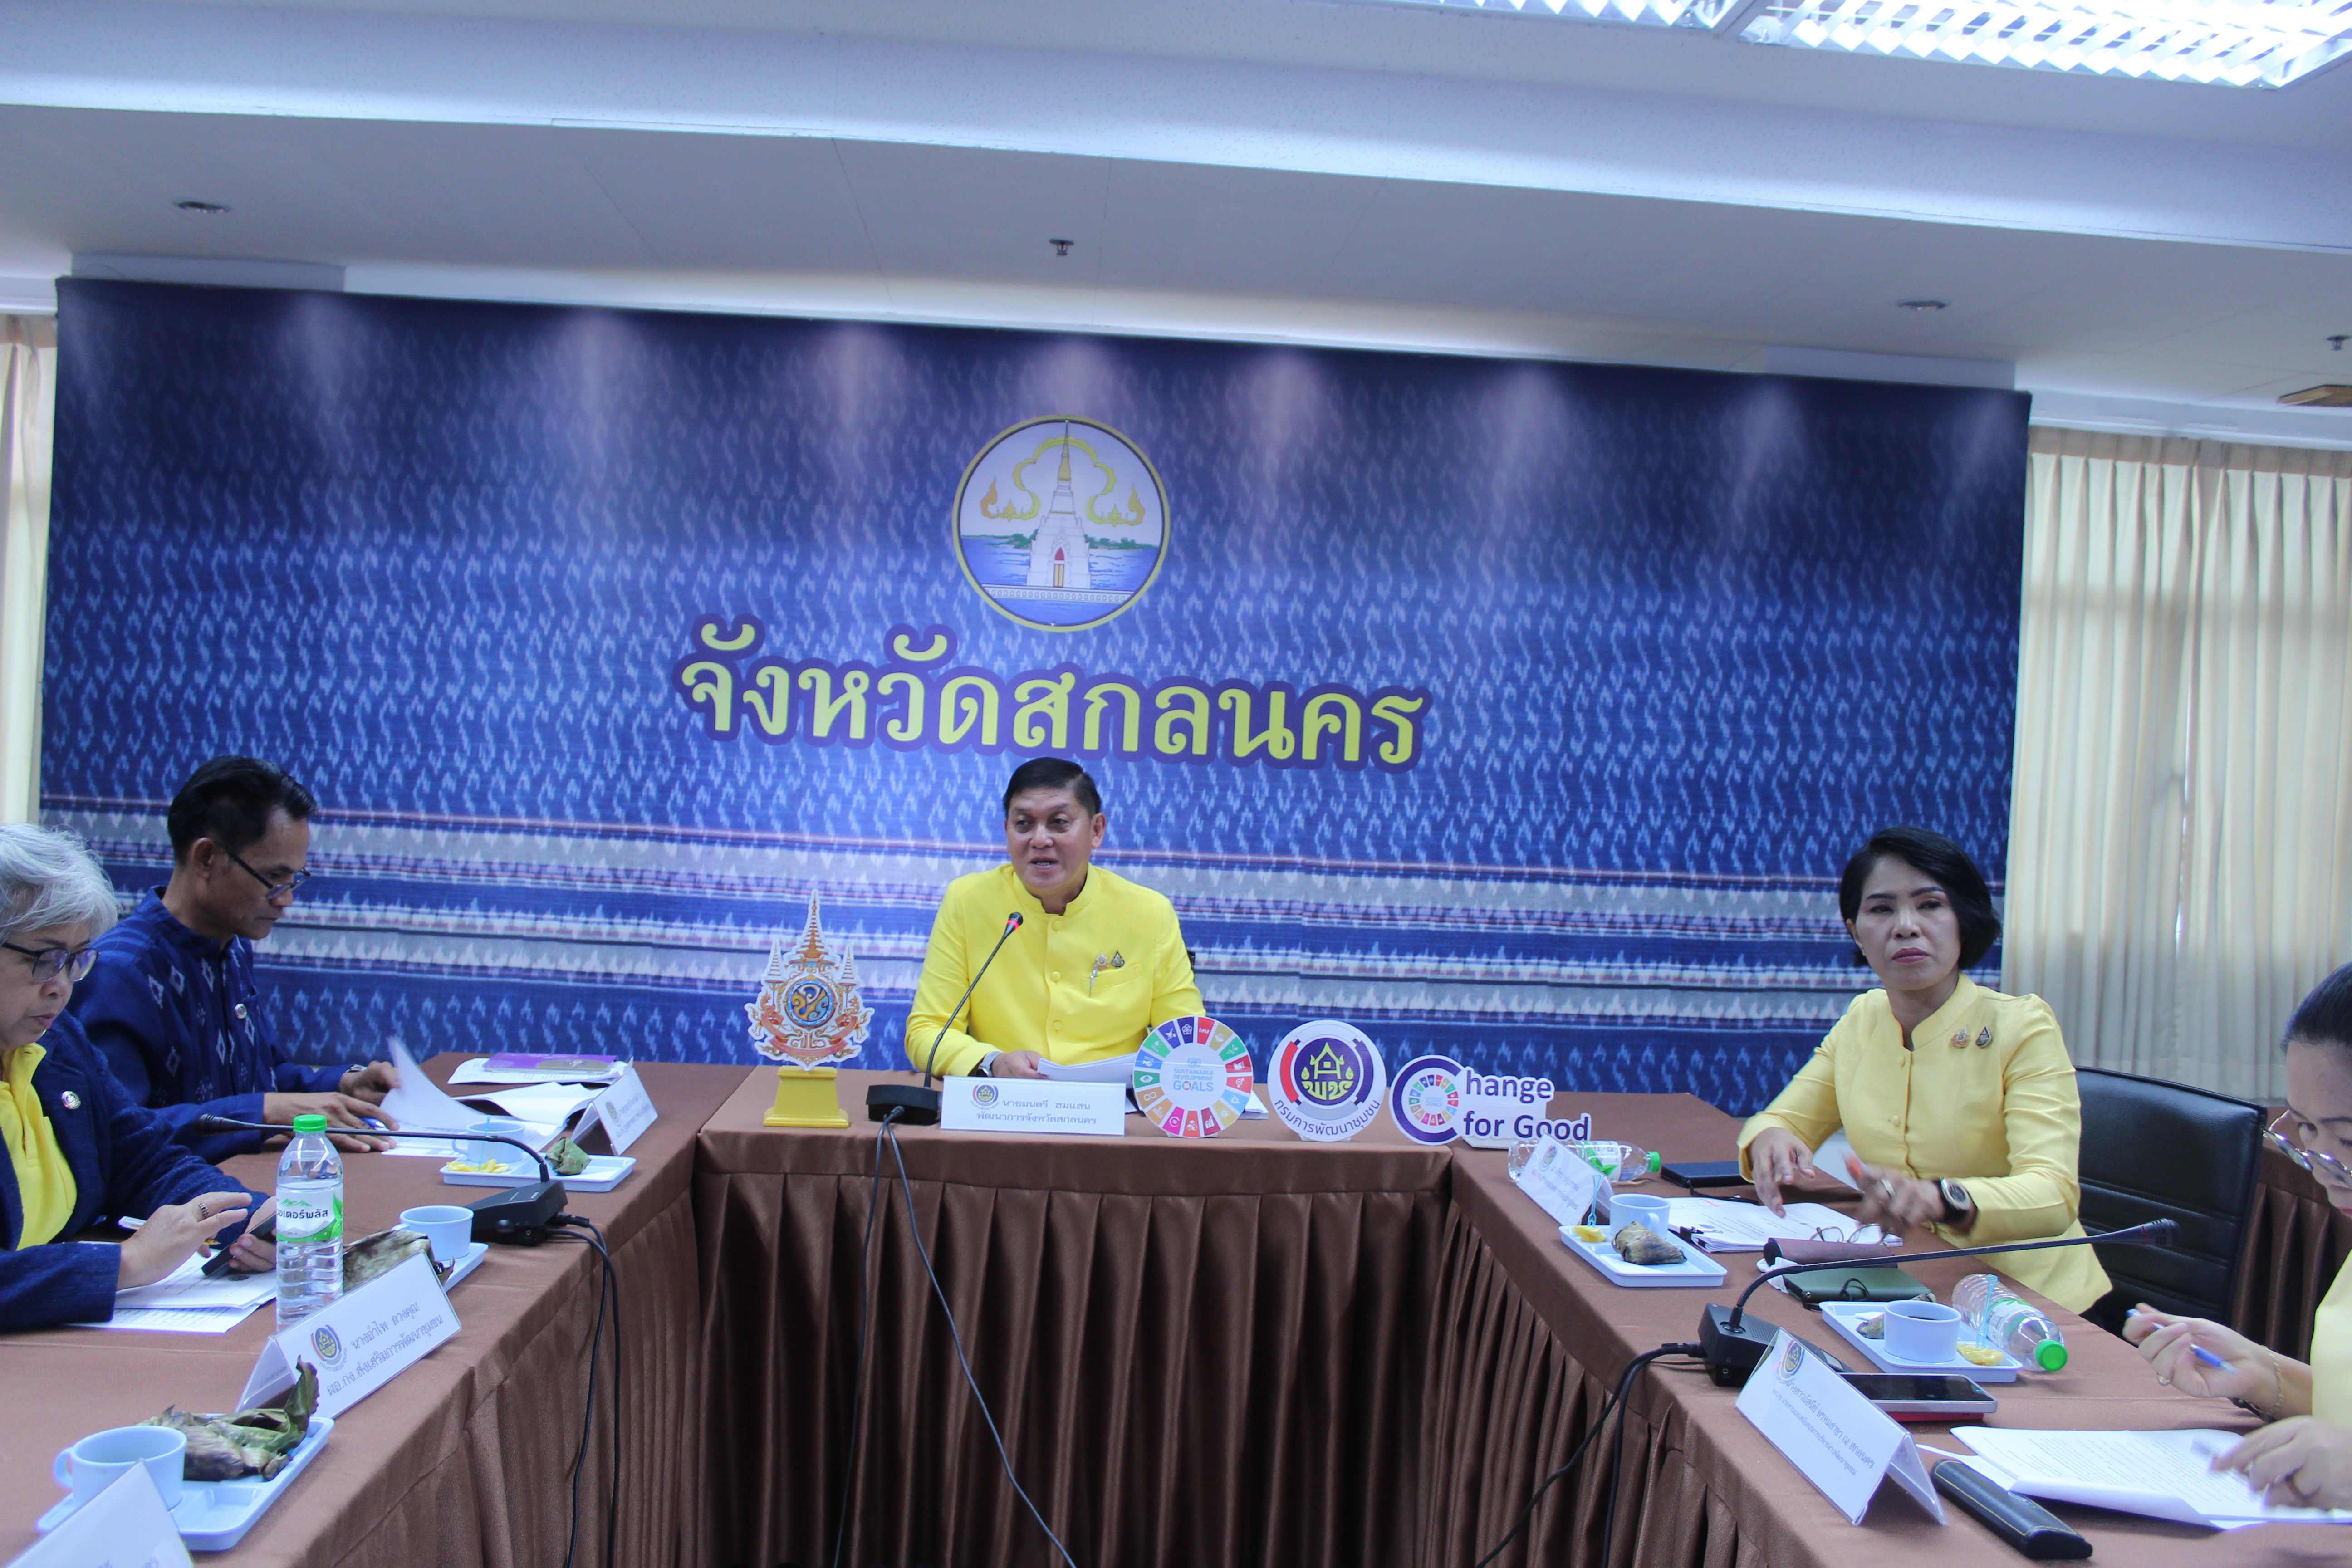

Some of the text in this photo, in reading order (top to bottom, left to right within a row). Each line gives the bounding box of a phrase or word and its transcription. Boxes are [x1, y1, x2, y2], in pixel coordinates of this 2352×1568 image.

[681, 622, 1423, 764] จังหวัดสกลนคร
[1173, 1080, 1214, 1092] GOALS
[976, 1110, 1097, 1124] พัฒนาการจังหวัดสกลนคร
[1002, 1099, 1049, 1108] นายมนตรี
[1274, 1100, 1380, 1136] กรมการพัฒนาชุมชน
[1464, 1111, 1588, 1141] for Good
[351, 1302, 420, 1349] นางอำไพ ดวงคุณ
[1842, 1436, 1850, 1446] ณ
[1849, 1442, 1875, 1469] สกลนคร
